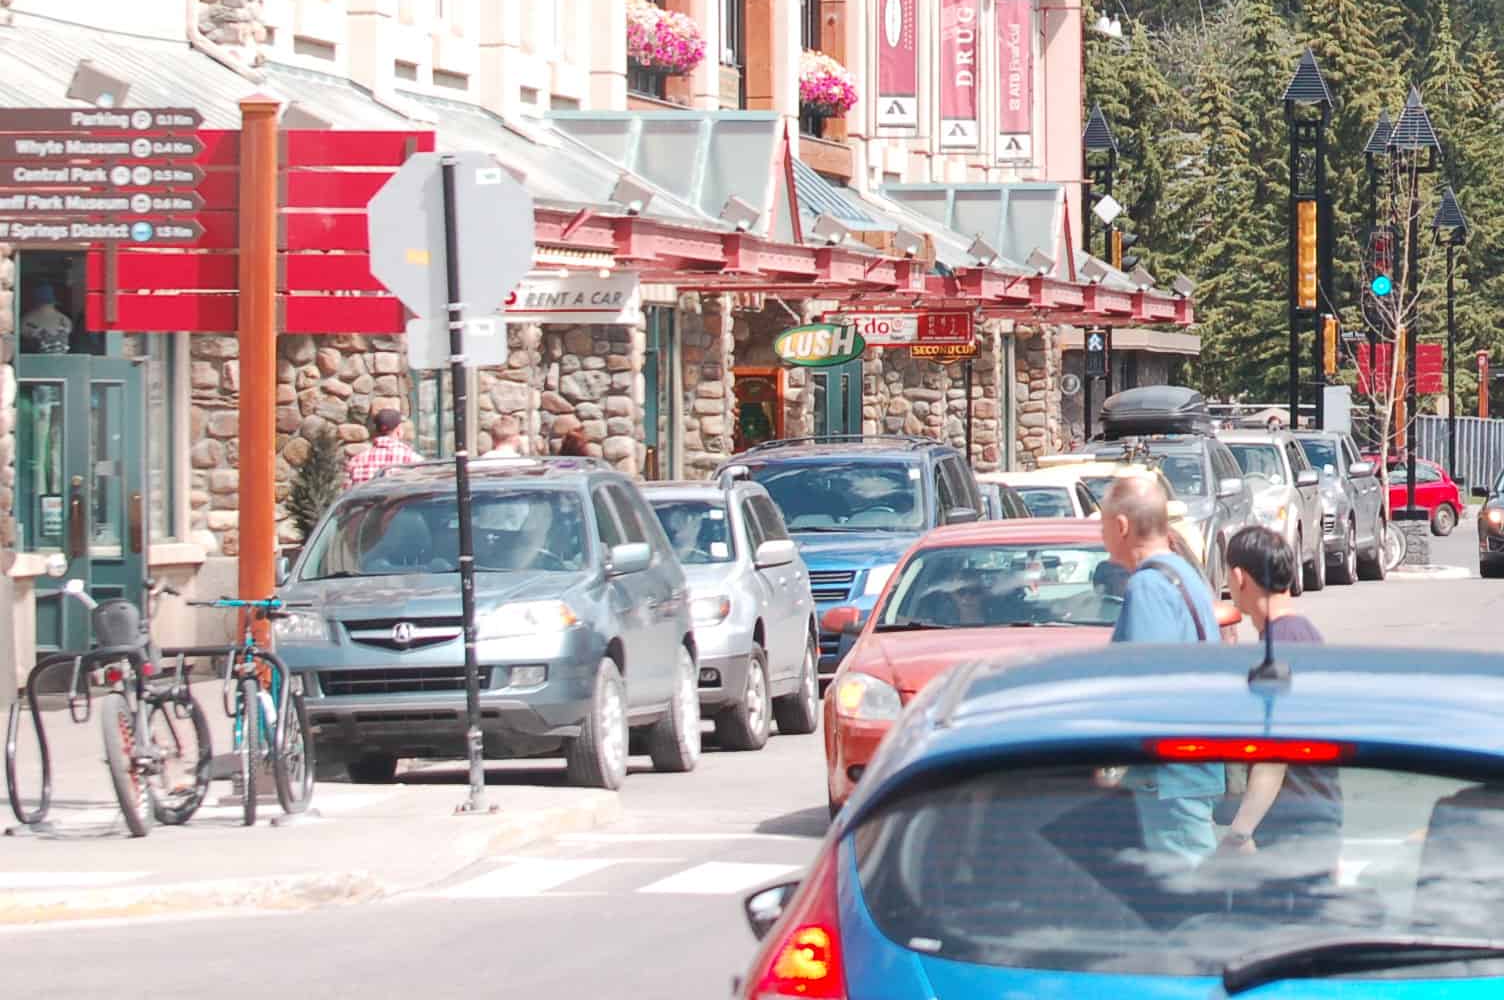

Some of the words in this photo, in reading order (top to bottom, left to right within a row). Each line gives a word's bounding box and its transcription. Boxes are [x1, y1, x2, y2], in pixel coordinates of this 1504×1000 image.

[956, 6, 975, 88] DRUG
[71, 111, 130, 129] Parking
[15, 139, 65, 157] Whyte
[66, 139, 130, 155] Museum
[13, 166, 69, 182] Central
[71, 167, 107, 182] Park
[27, 195, 64, 210] Park
[65, 195, 129, 210] Museum
[11, 222, 69, 241] Springs
[71, 222, 130, 239] District
[525, 291, 570, 307] RENT
[570, 291, 584, 305] A
[590, 291, 624, 306] CAR
[782, 325, 858, 359] LUSH
[912, 345, 955, 355] SECOND
